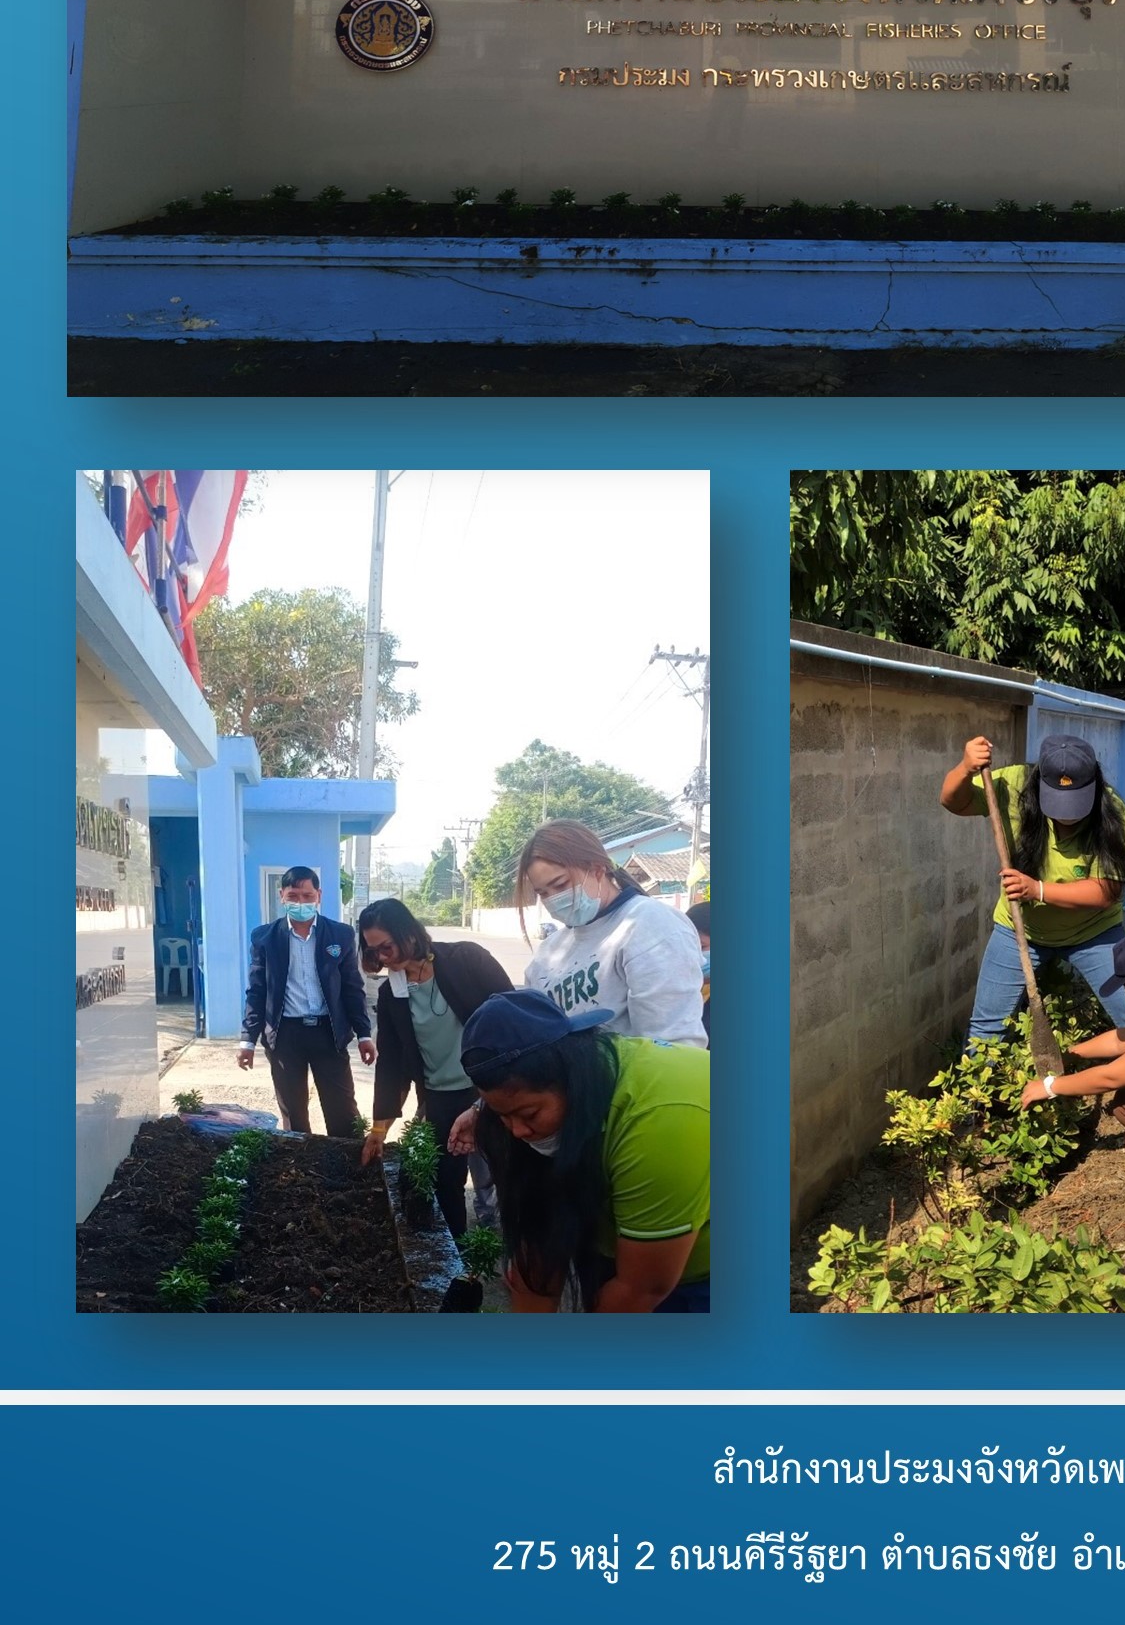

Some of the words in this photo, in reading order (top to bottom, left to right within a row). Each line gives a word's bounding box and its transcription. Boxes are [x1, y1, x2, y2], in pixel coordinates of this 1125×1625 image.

[586, 19, 722, 37] PHETCHABURI
[736, 21, 853, 39] PROVINCIAL
[866, 23, 962, 40] FISHERIES
[975, 24, 1047, 40] OFFICE
[559, 61, 690, 88] กรมประมง
[702, 62, 1073, 93] กระทรวงเกษตรและสหกรณ์
